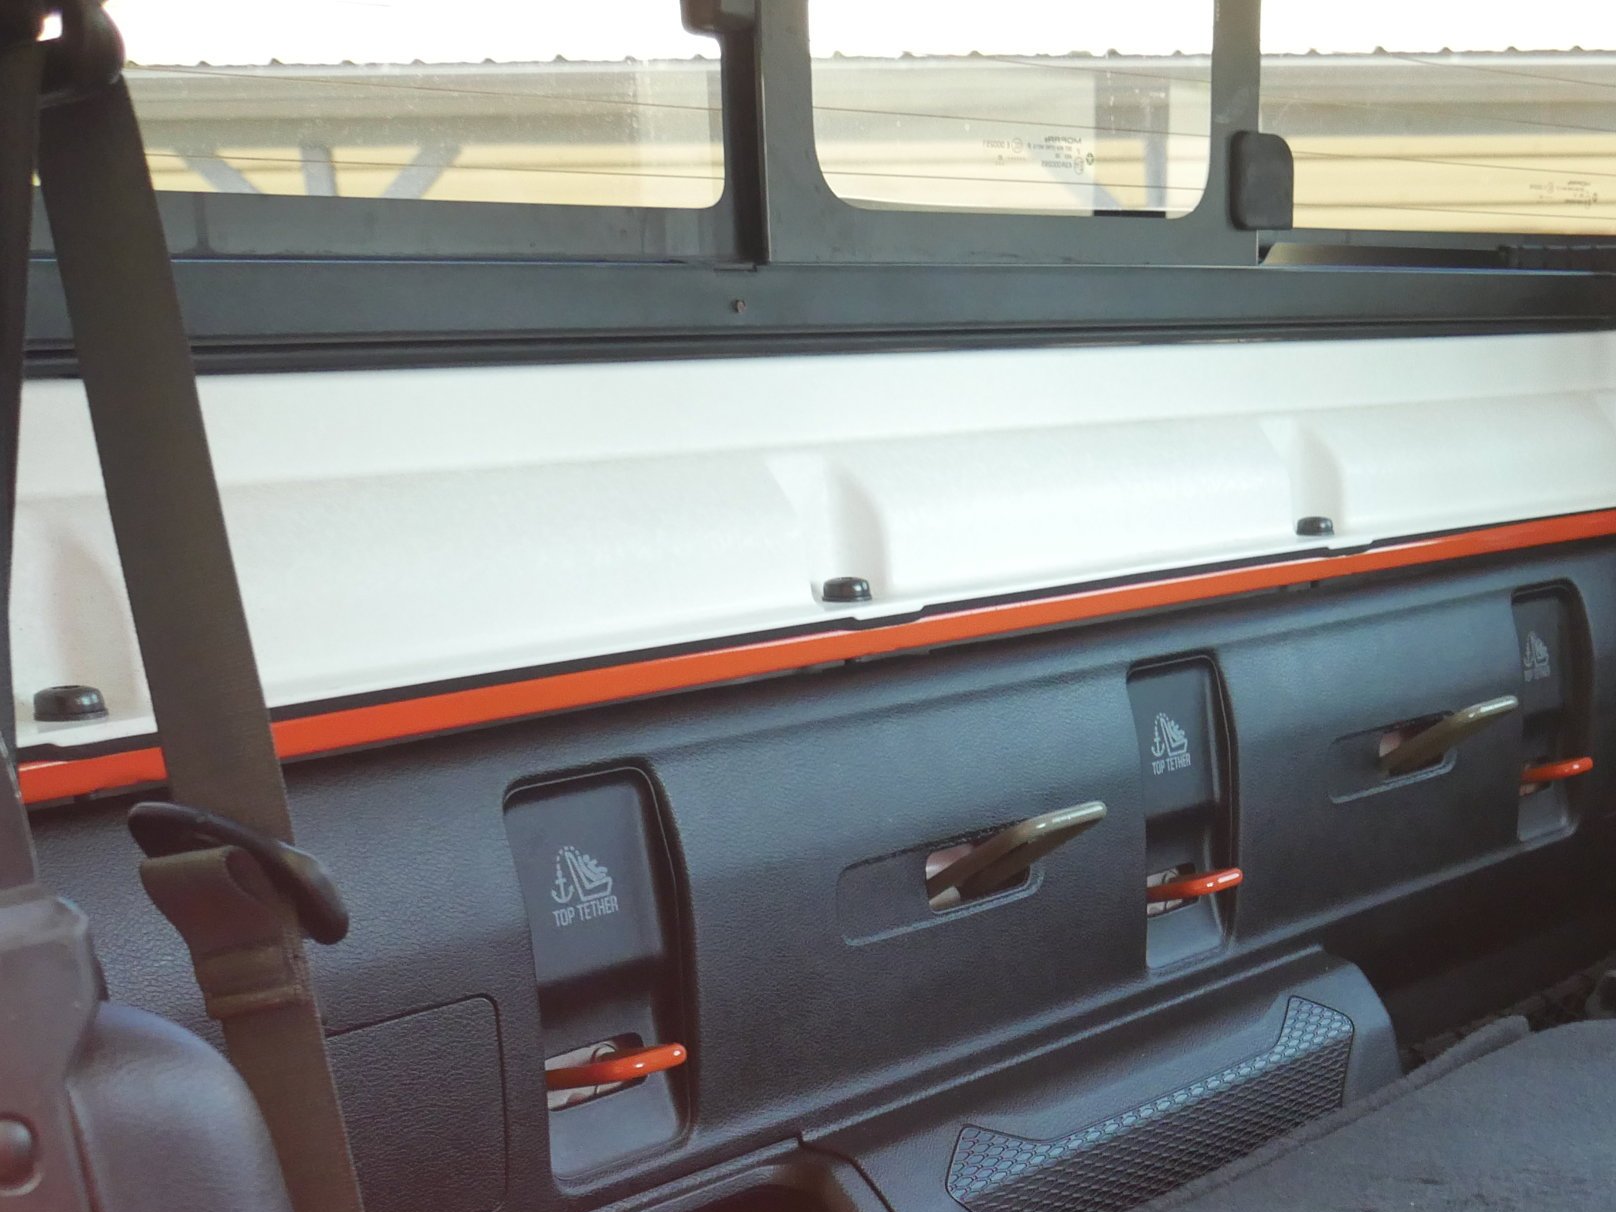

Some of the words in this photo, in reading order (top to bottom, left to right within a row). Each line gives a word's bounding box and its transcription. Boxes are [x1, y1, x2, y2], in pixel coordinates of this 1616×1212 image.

[1152, 761, 1165, 776] TOP
[1166, 753, 1191, 772] TETHER
[552, 908, 575, 927] TOP
[577, 896, 619, 921] TETHER
